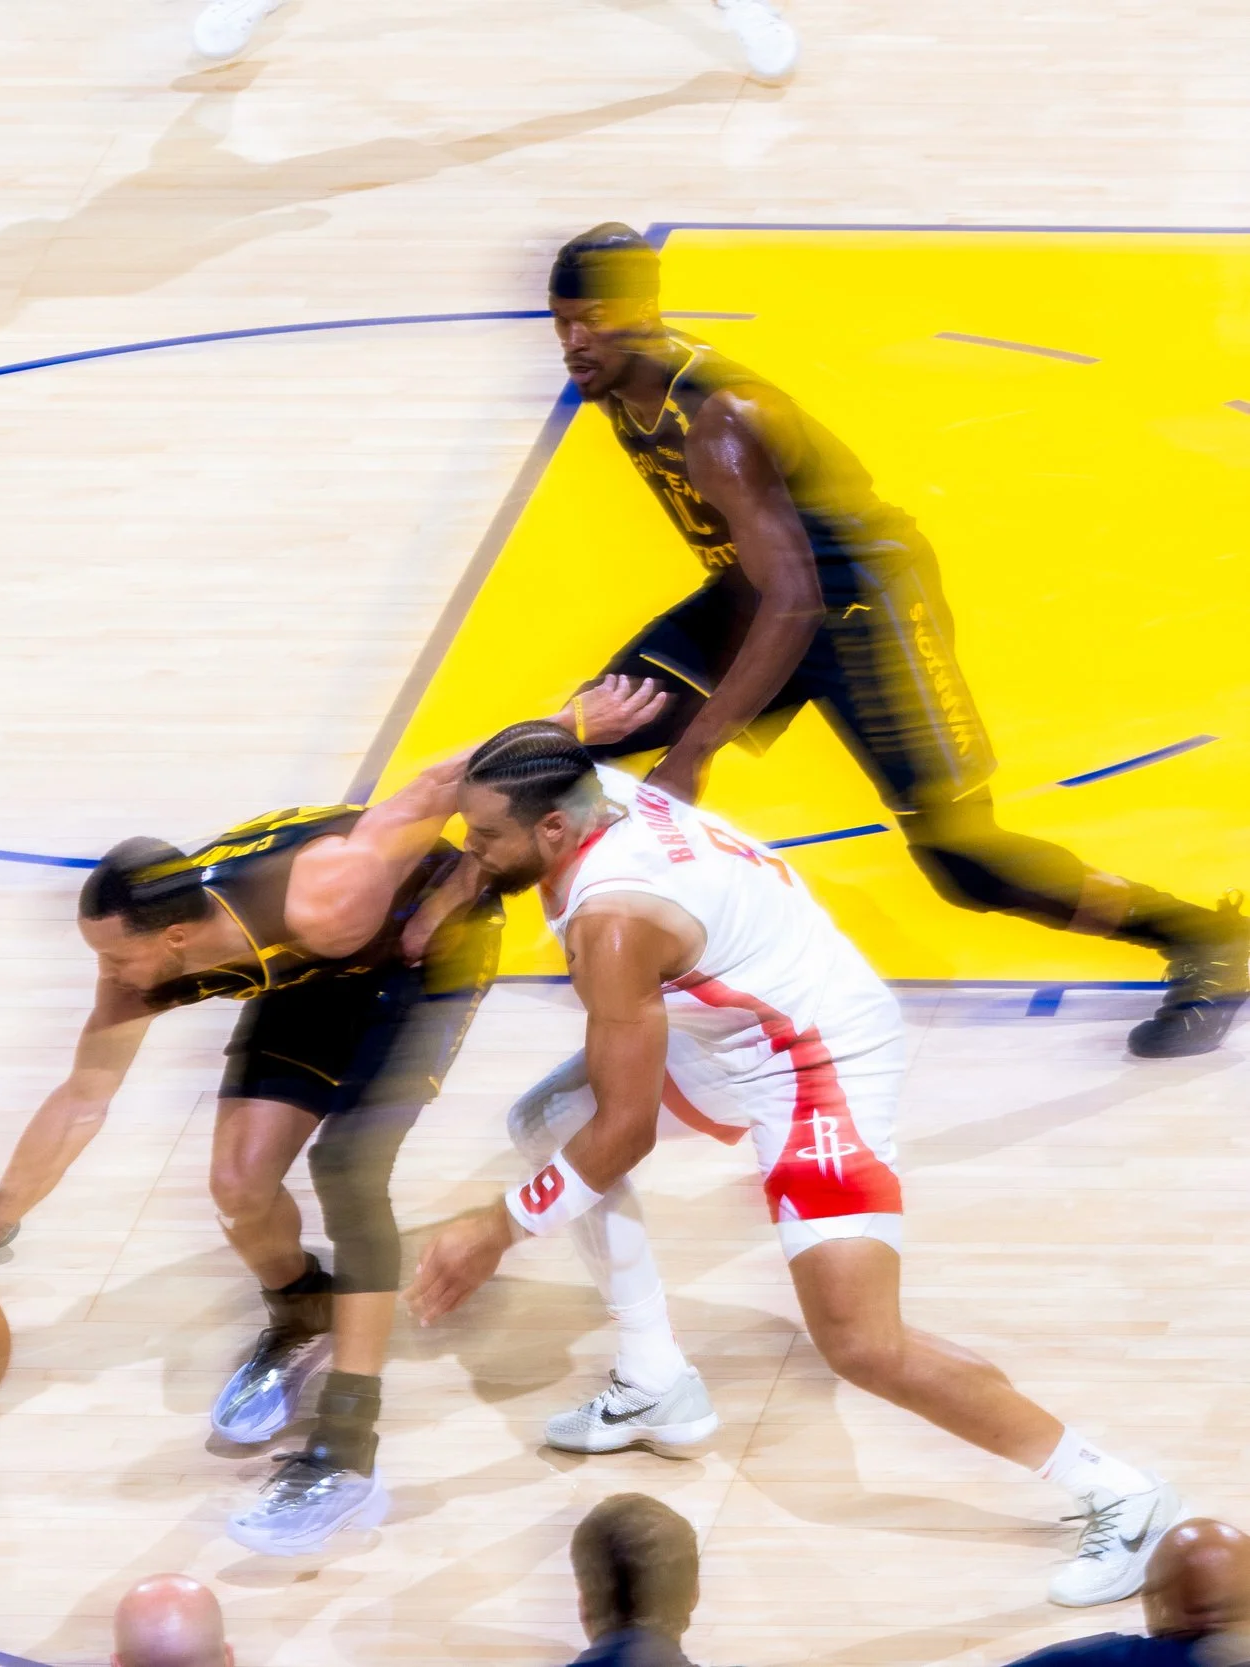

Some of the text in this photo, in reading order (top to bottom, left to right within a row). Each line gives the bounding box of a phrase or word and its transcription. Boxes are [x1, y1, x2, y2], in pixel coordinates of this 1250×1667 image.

[690, 542, 739, 567] TAT
[909, 602, 973, 757] WARRIORS
[636, 785, 696, 864] BROOKS
[518, 1163, 566, 1215] 9
